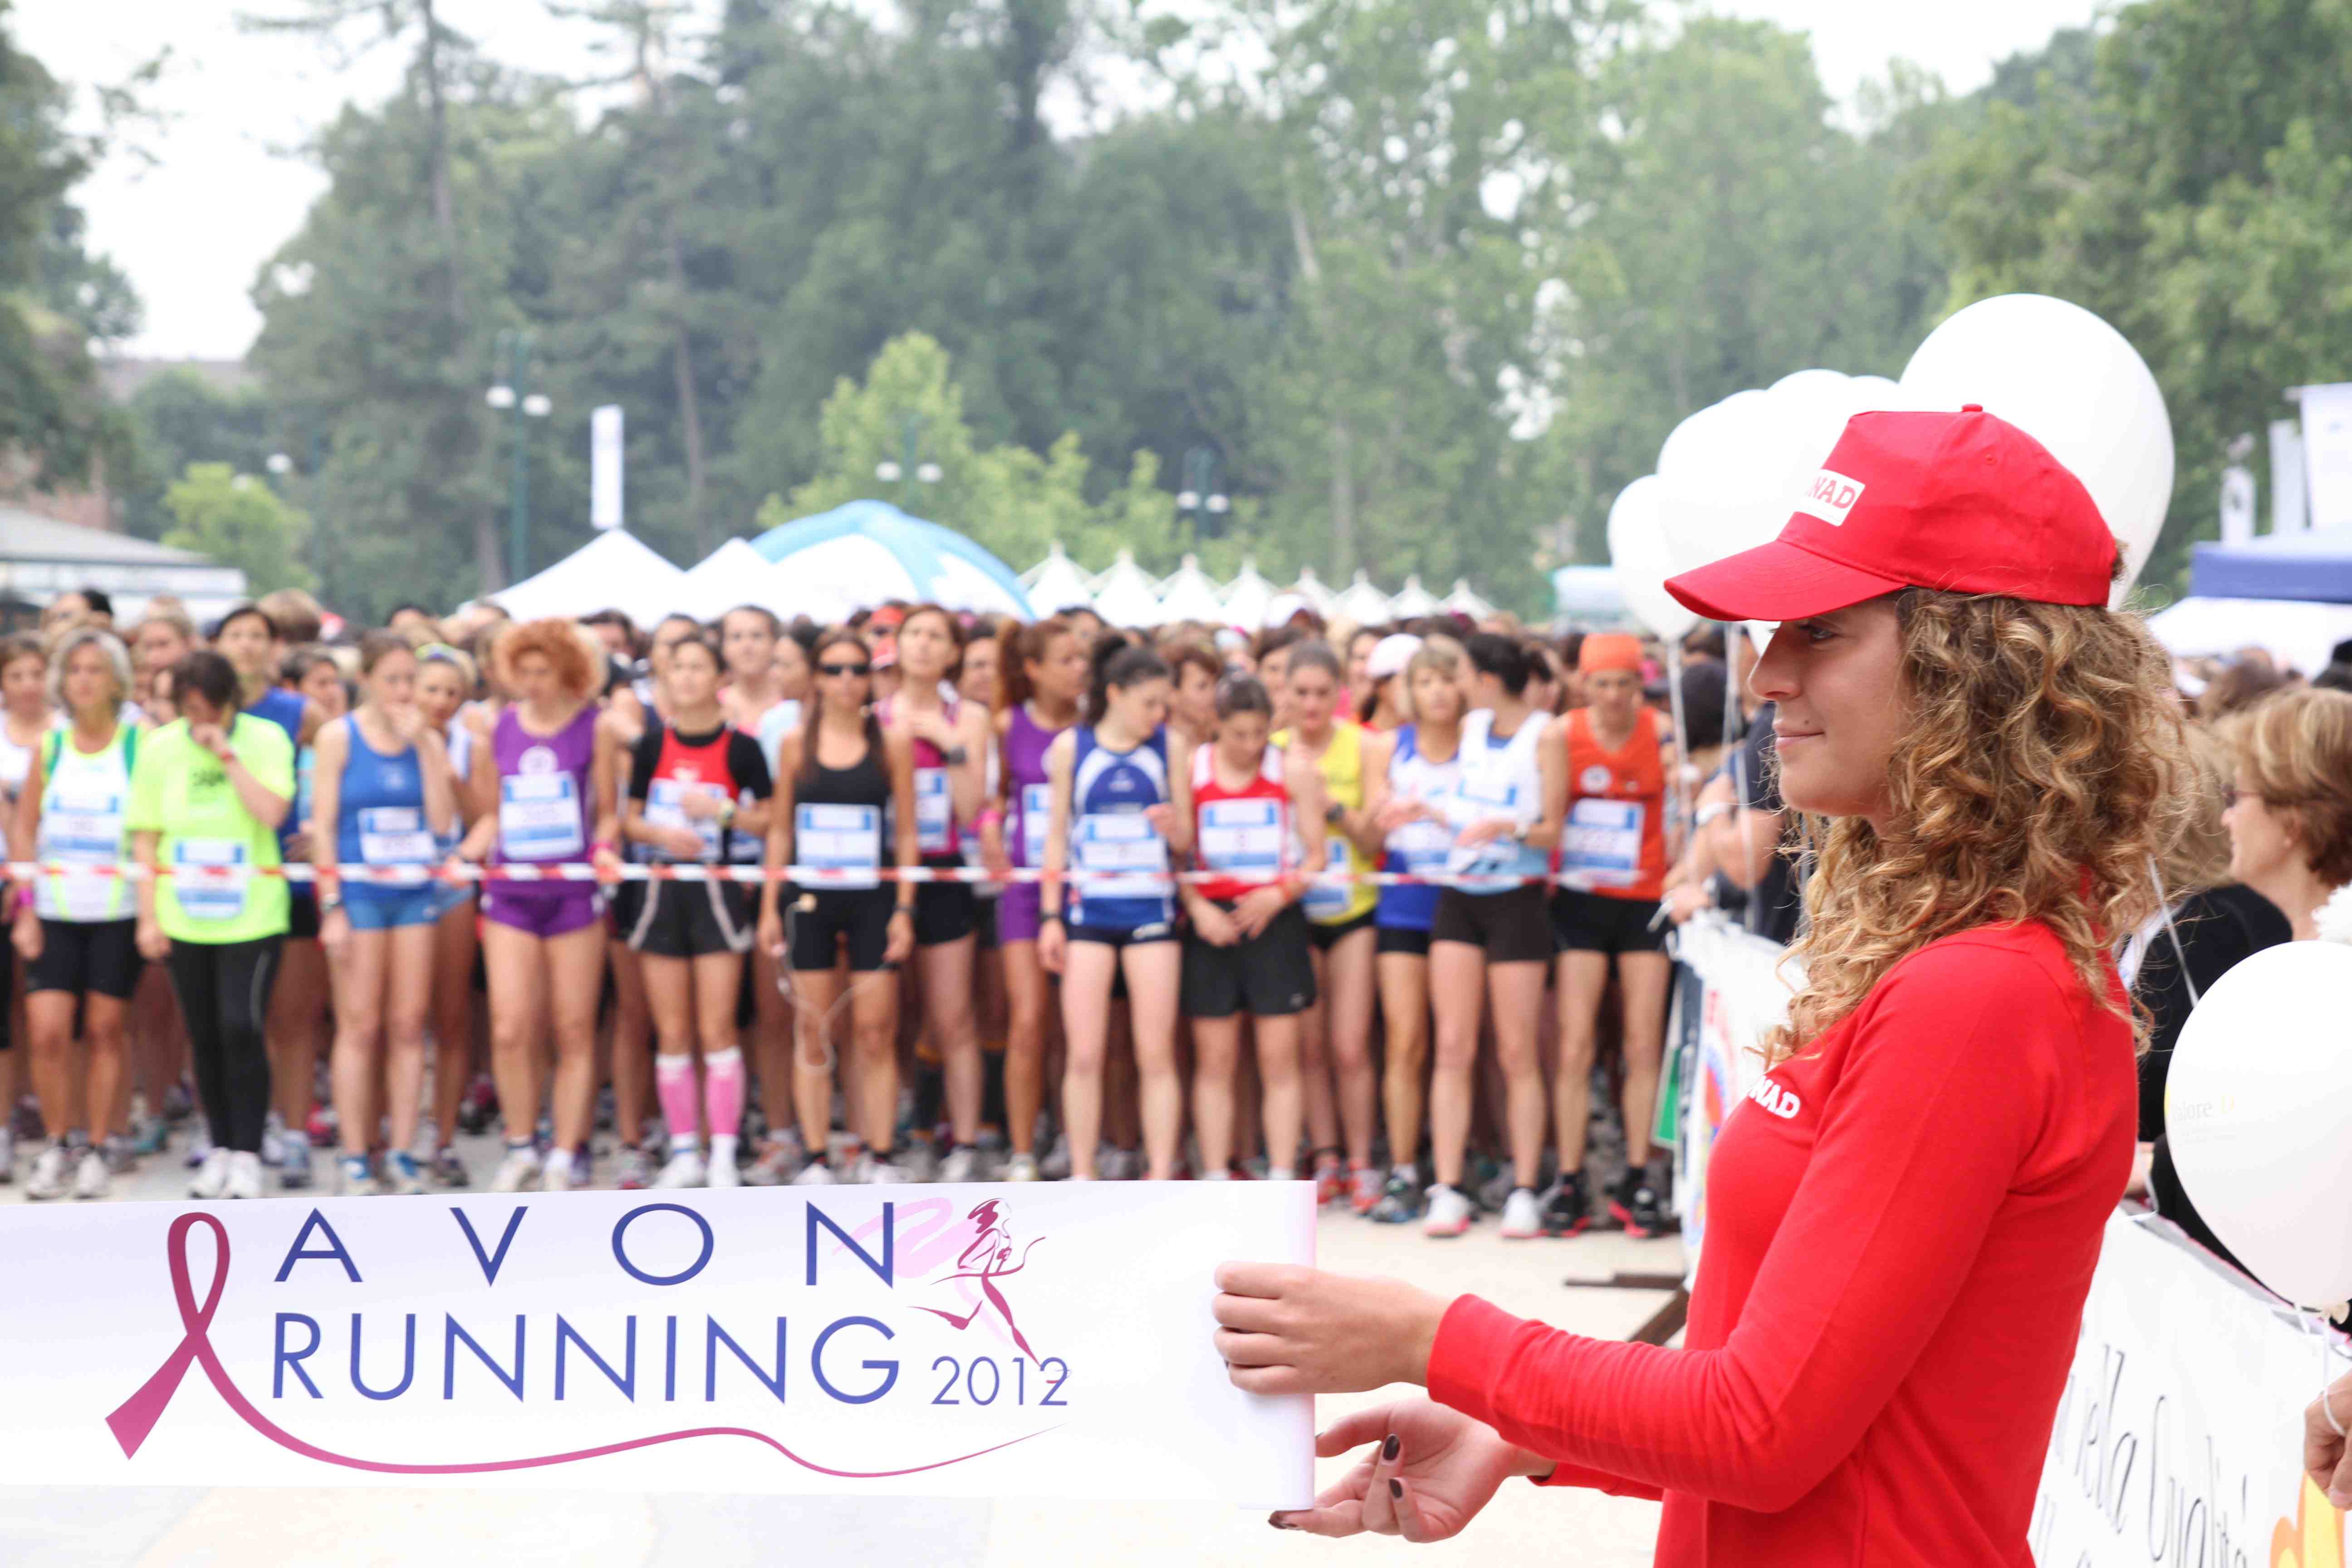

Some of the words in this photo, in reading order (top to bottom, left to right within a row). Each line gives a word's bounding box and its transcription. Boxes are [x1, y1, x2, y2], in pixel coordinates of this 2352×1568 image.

[1805, 476, 1856, 509] NAD
[1748, 1075, 1801, 1118] NAD
[274, 1202, 894, 1289] AVON
[273, 1312, 900, 1405] RUNNING
[931, 1356, 1069, 1406] 2012
